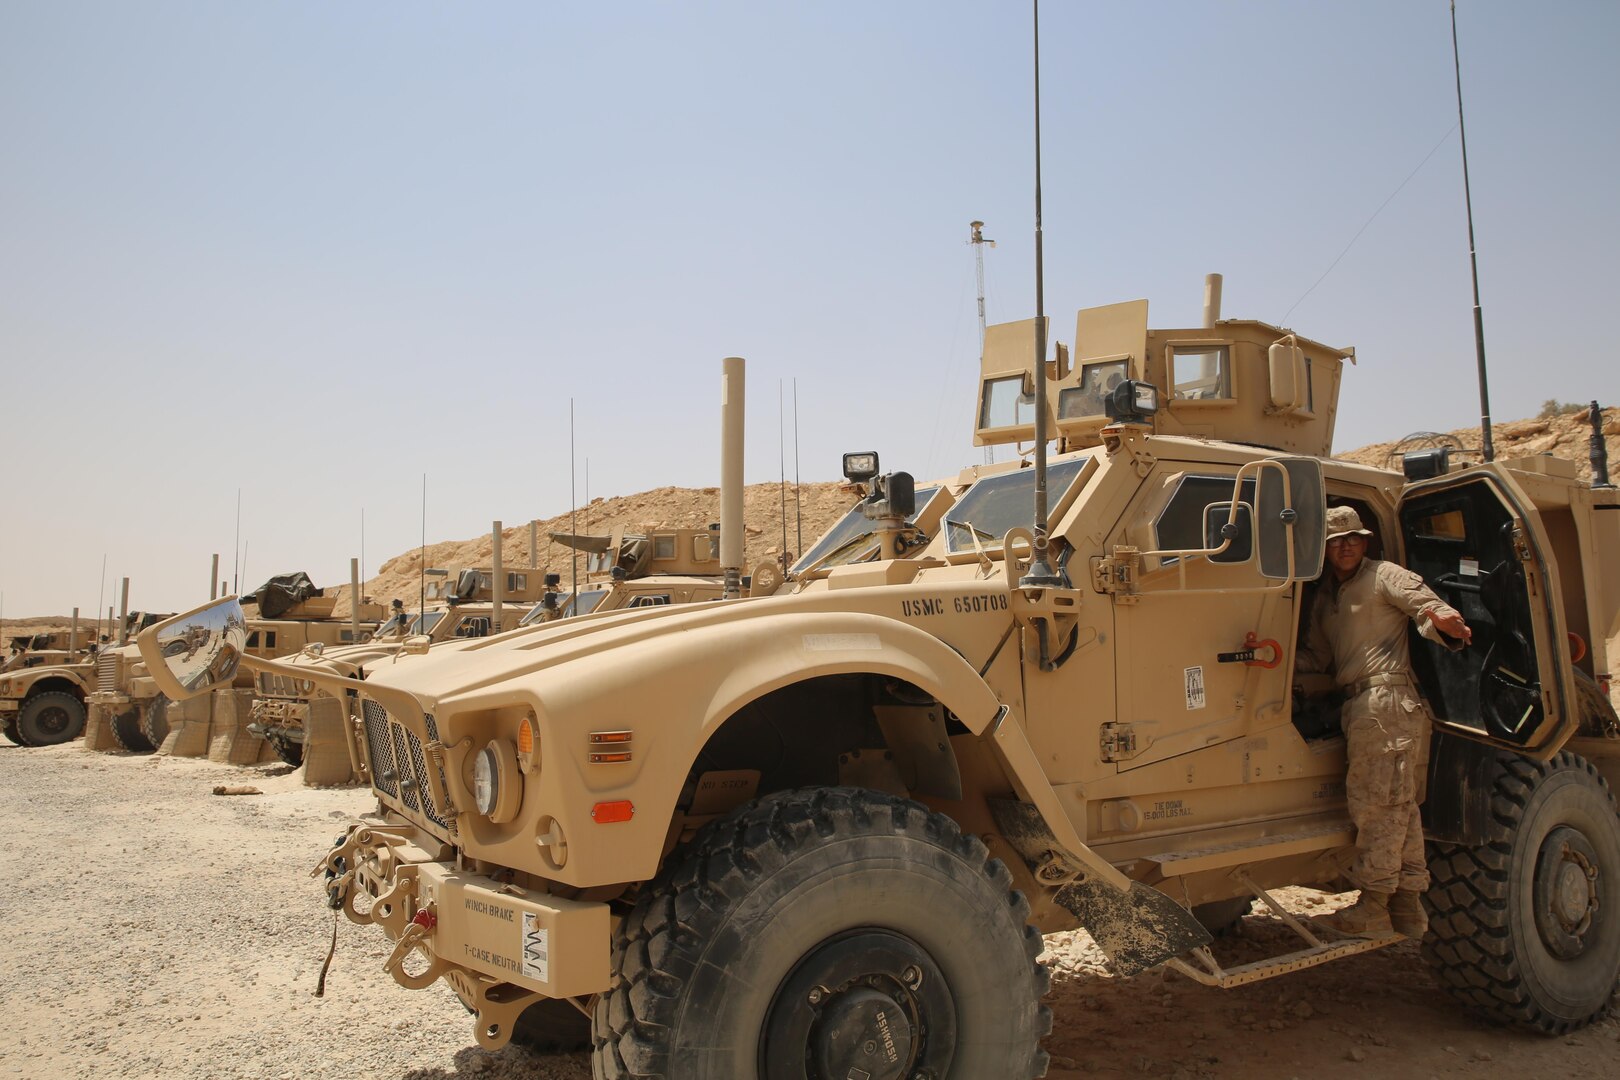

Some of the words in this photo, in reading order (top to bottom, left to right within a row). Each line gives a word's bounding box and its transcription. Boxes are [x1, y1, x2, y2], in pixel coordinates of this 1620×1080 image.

[902, 598, 944, 617] USMC
[953, 594, 1008, 613] 650708
[1153, 801, 1165, 811] TIE
[1165, 800, 1183, 810] DOWN
[464, 898, 488, 915] WINCH
[489, 904, 514, 922] BRAKE
[464, 943, 491, 964] T-CASE
[876, 1011, 898, 1063] OSHKOSH
